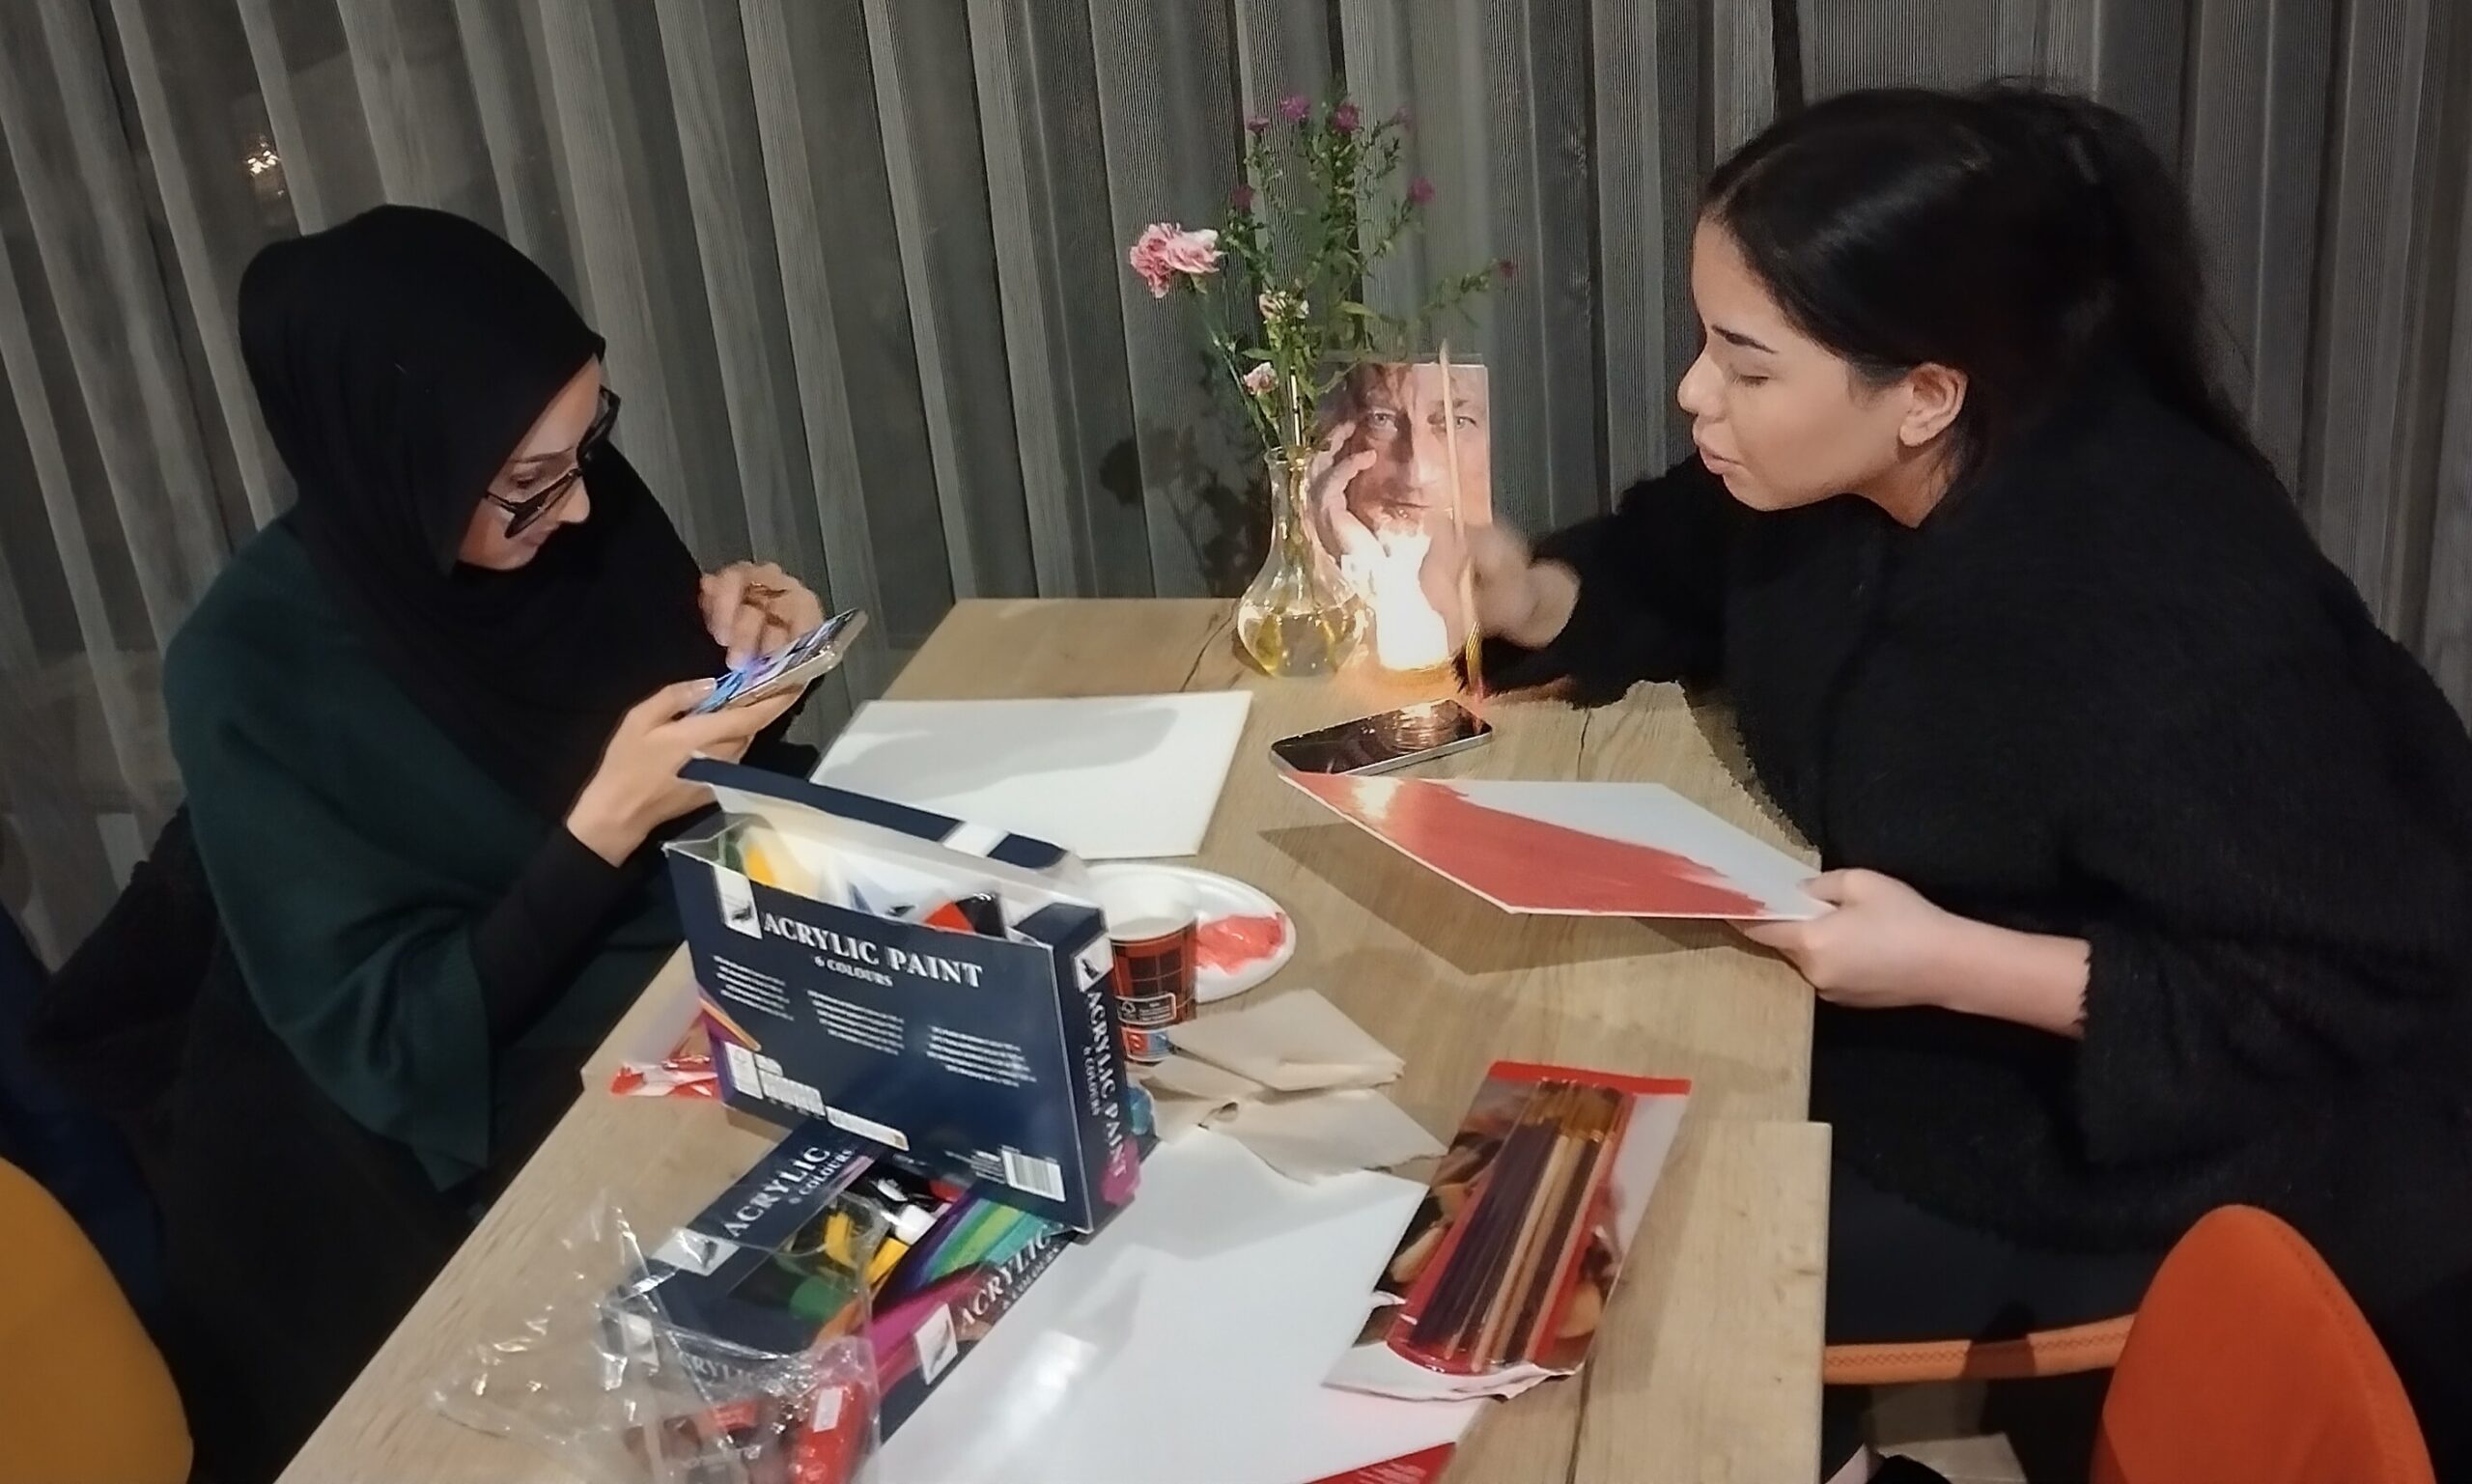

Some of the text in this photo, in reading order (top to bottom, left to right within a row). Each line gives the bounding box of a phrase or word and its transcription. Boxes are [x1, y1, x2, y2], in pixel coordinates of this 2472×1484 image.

[763, 912, 983, 988] ACRYLIC PAINT
[814, 956, 894, 988] 6 COLOURS
[1087, 991, 1127, 1177] ACRYLIC PAINT
[723, 1146, 831, 1238] ACRYLIC
[798, 1148, 856, 1196] COLOURS
[959, 1222, 1053, 1327] ACRYLIC
